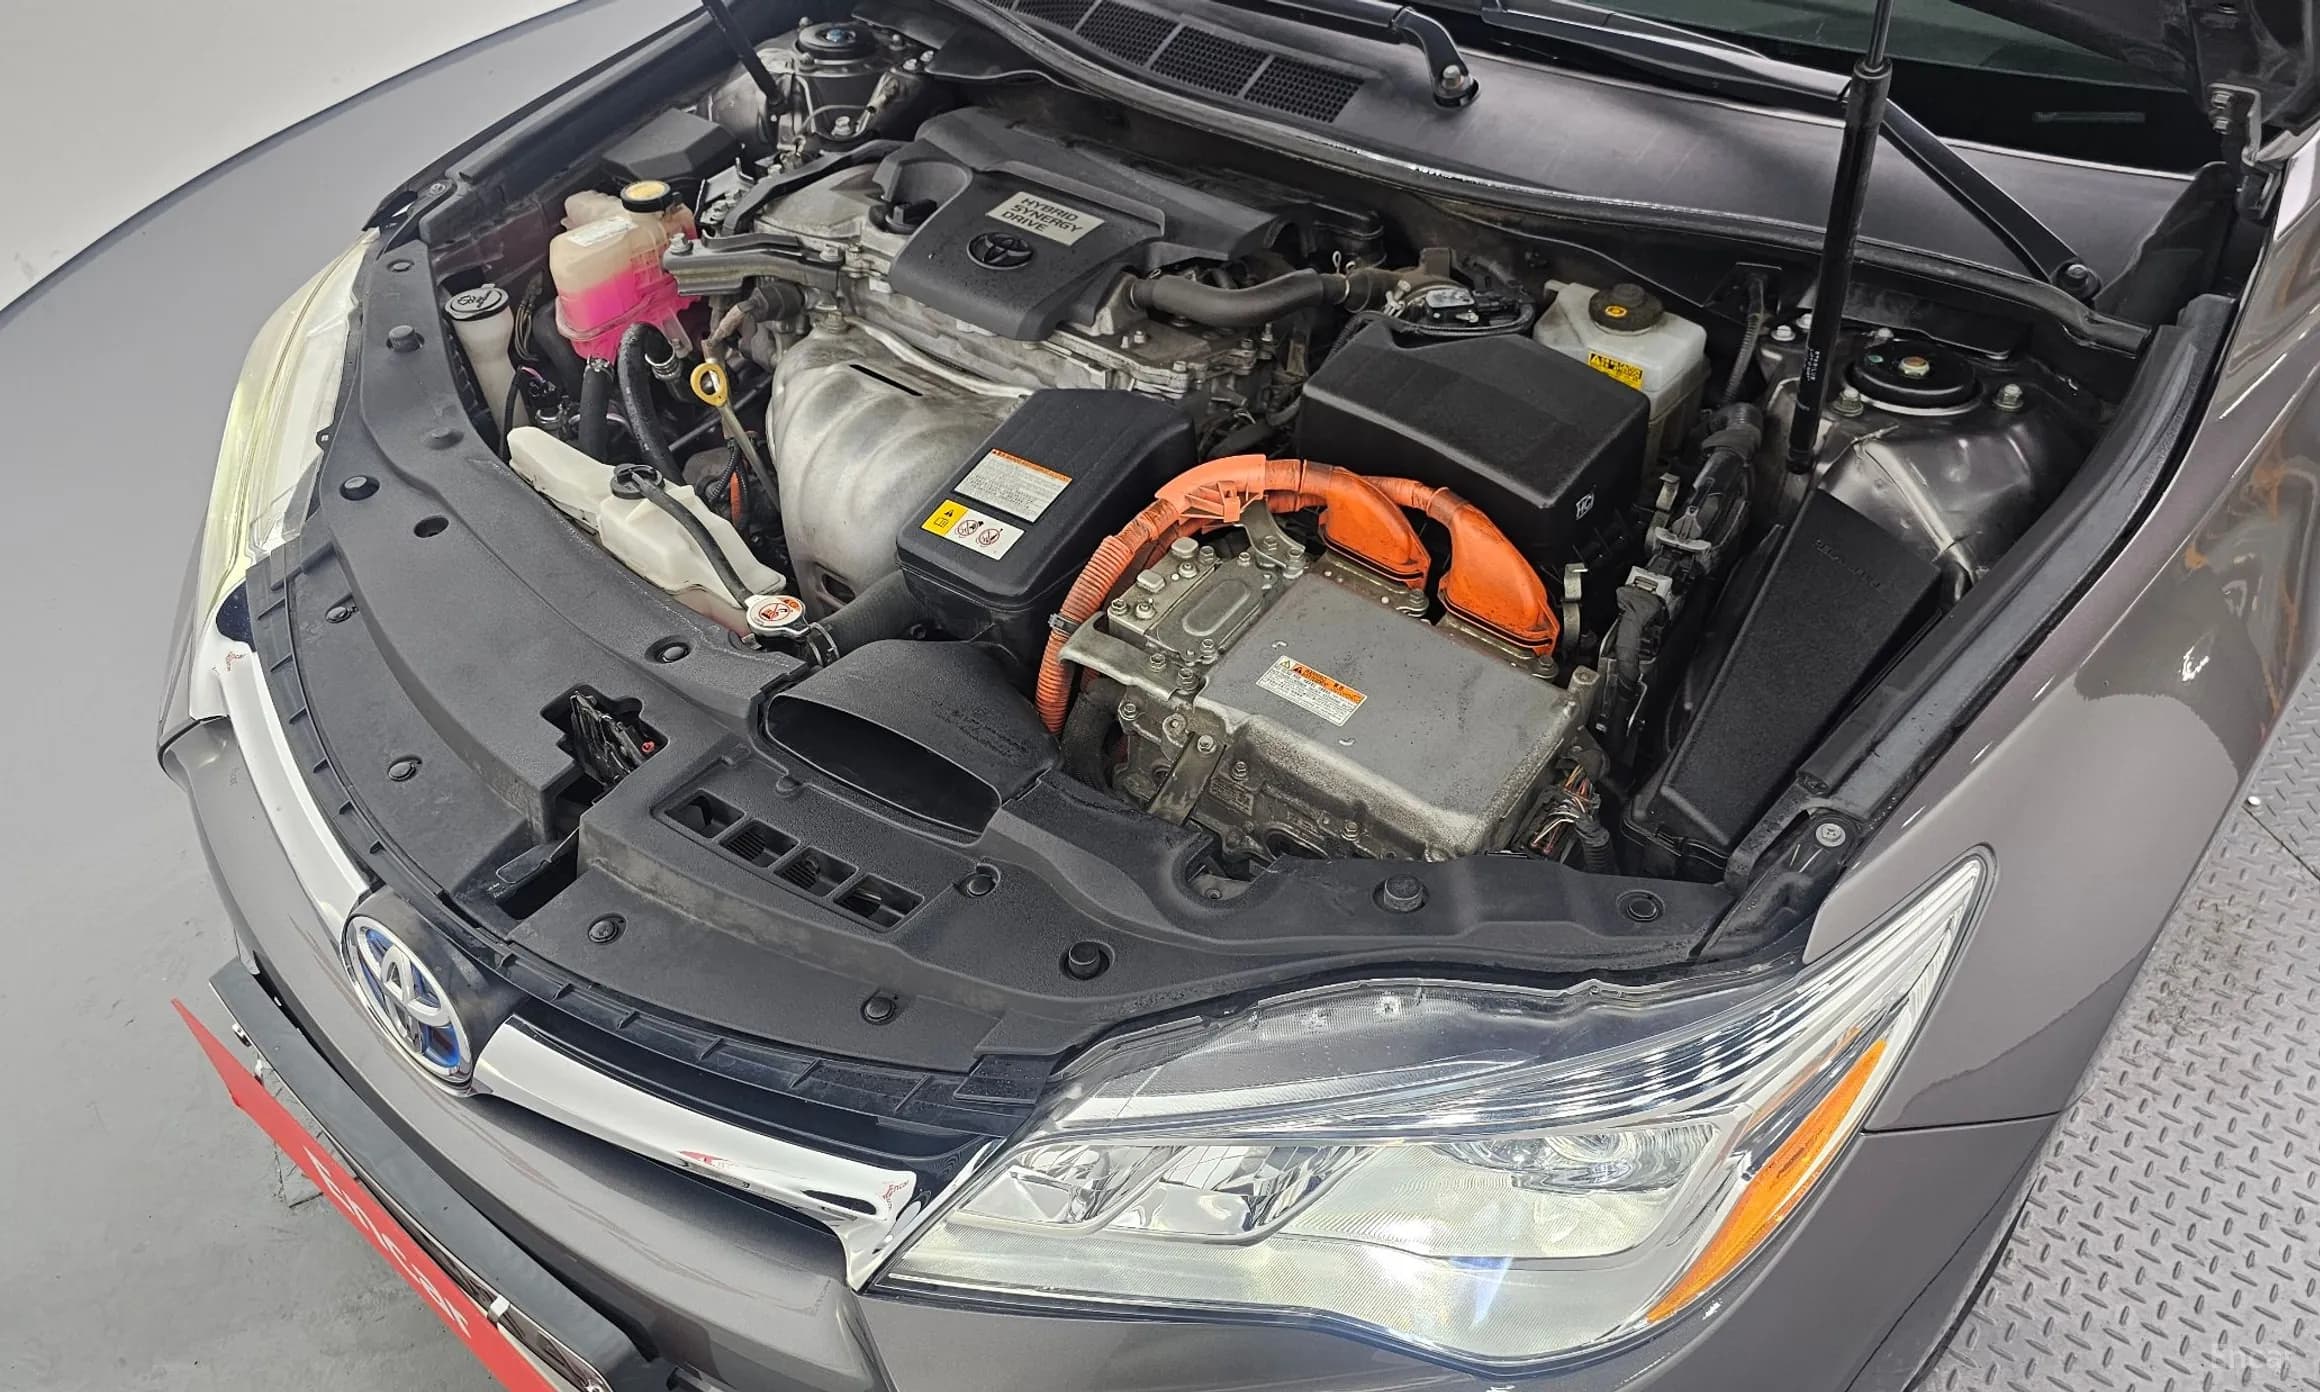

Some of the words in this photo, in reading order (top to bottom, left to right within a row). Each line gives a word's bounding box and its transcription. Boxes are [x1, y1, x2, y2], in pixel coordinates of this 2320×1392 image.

[1001, 211, 1048, 232] DRIVE
[1010, 204, 1083, 232] SYNERGY
[1021, 198, 1079, 222] HYBRID
